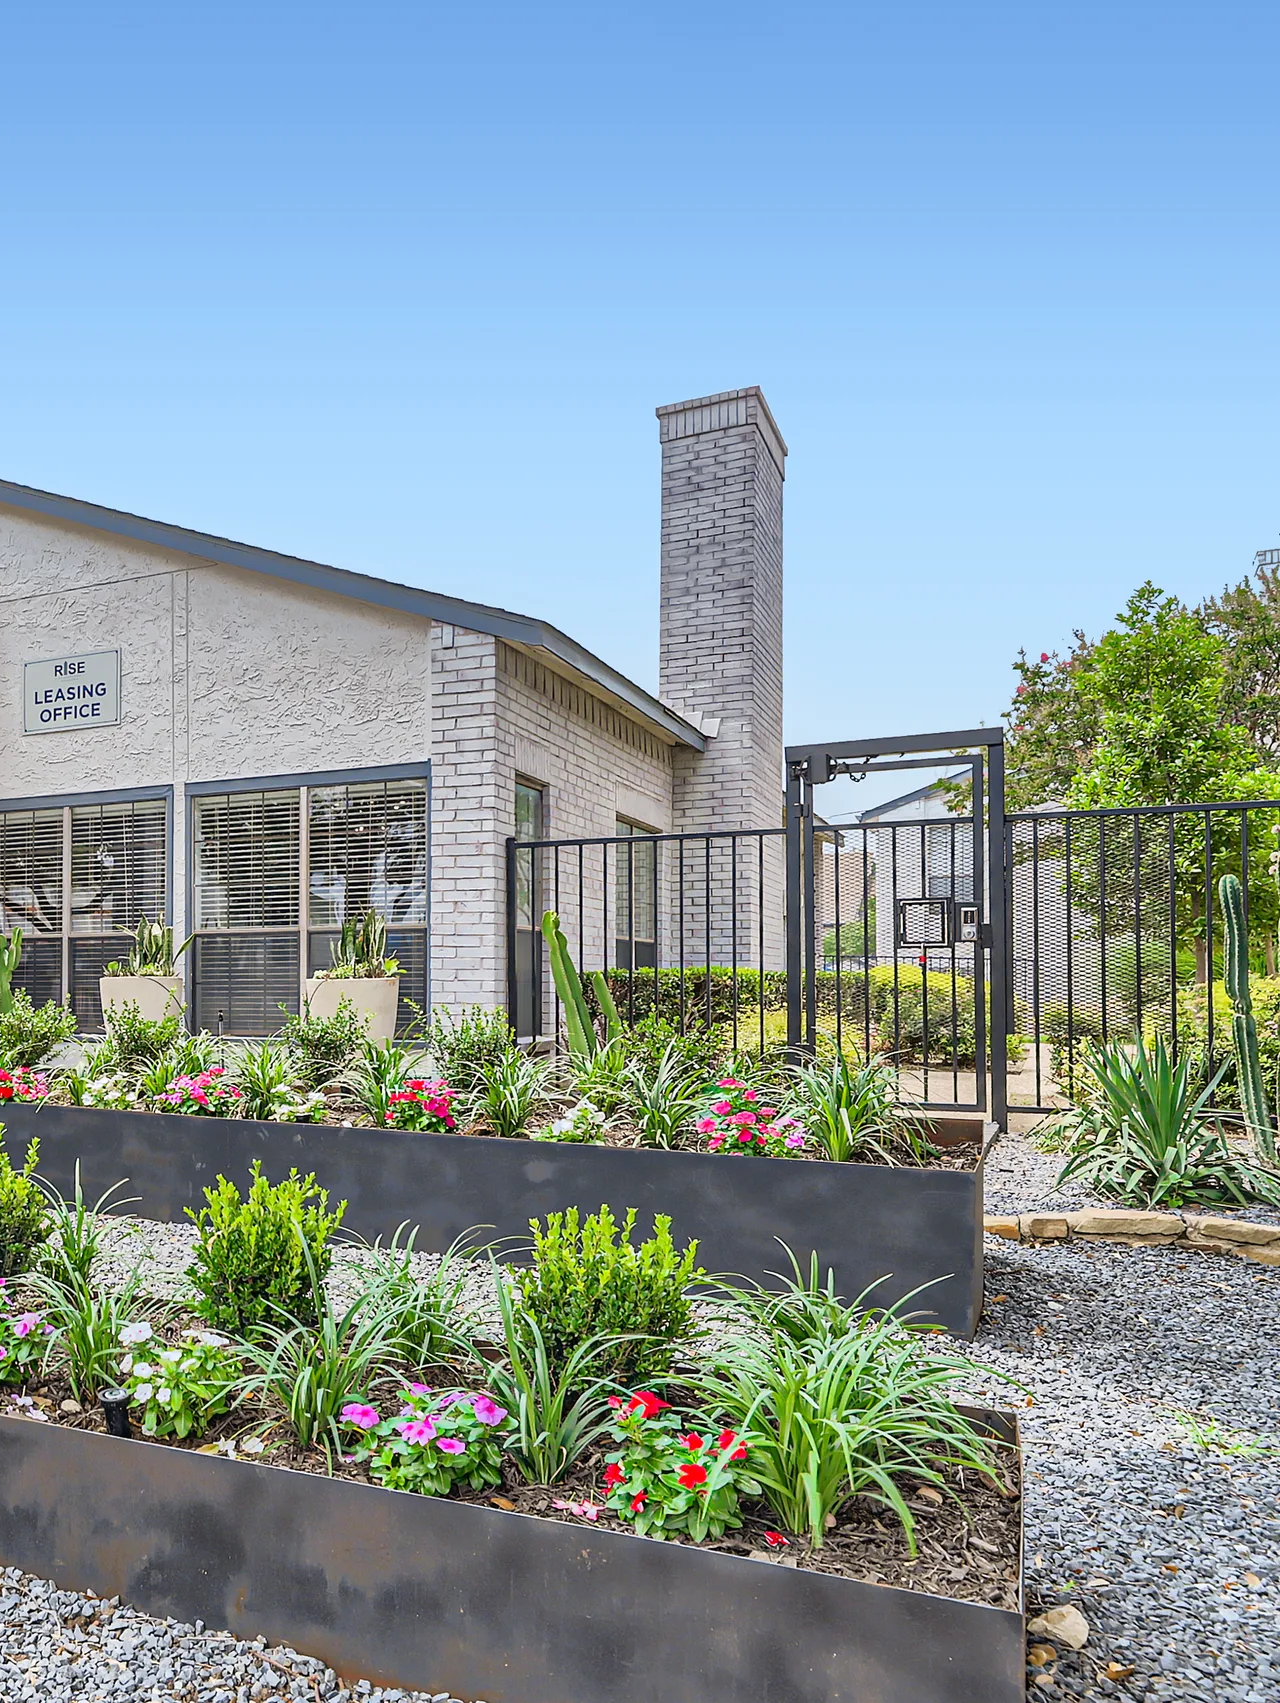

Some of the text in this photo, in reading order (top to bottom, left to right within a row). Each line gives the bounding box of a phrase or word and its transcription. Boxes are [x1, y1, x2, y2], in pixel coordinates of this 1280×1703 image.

[54, 661, 86, 677] RISE
[34, 682, 107, 705] LEASING
[39, 702, 101, 723] OFFICE
